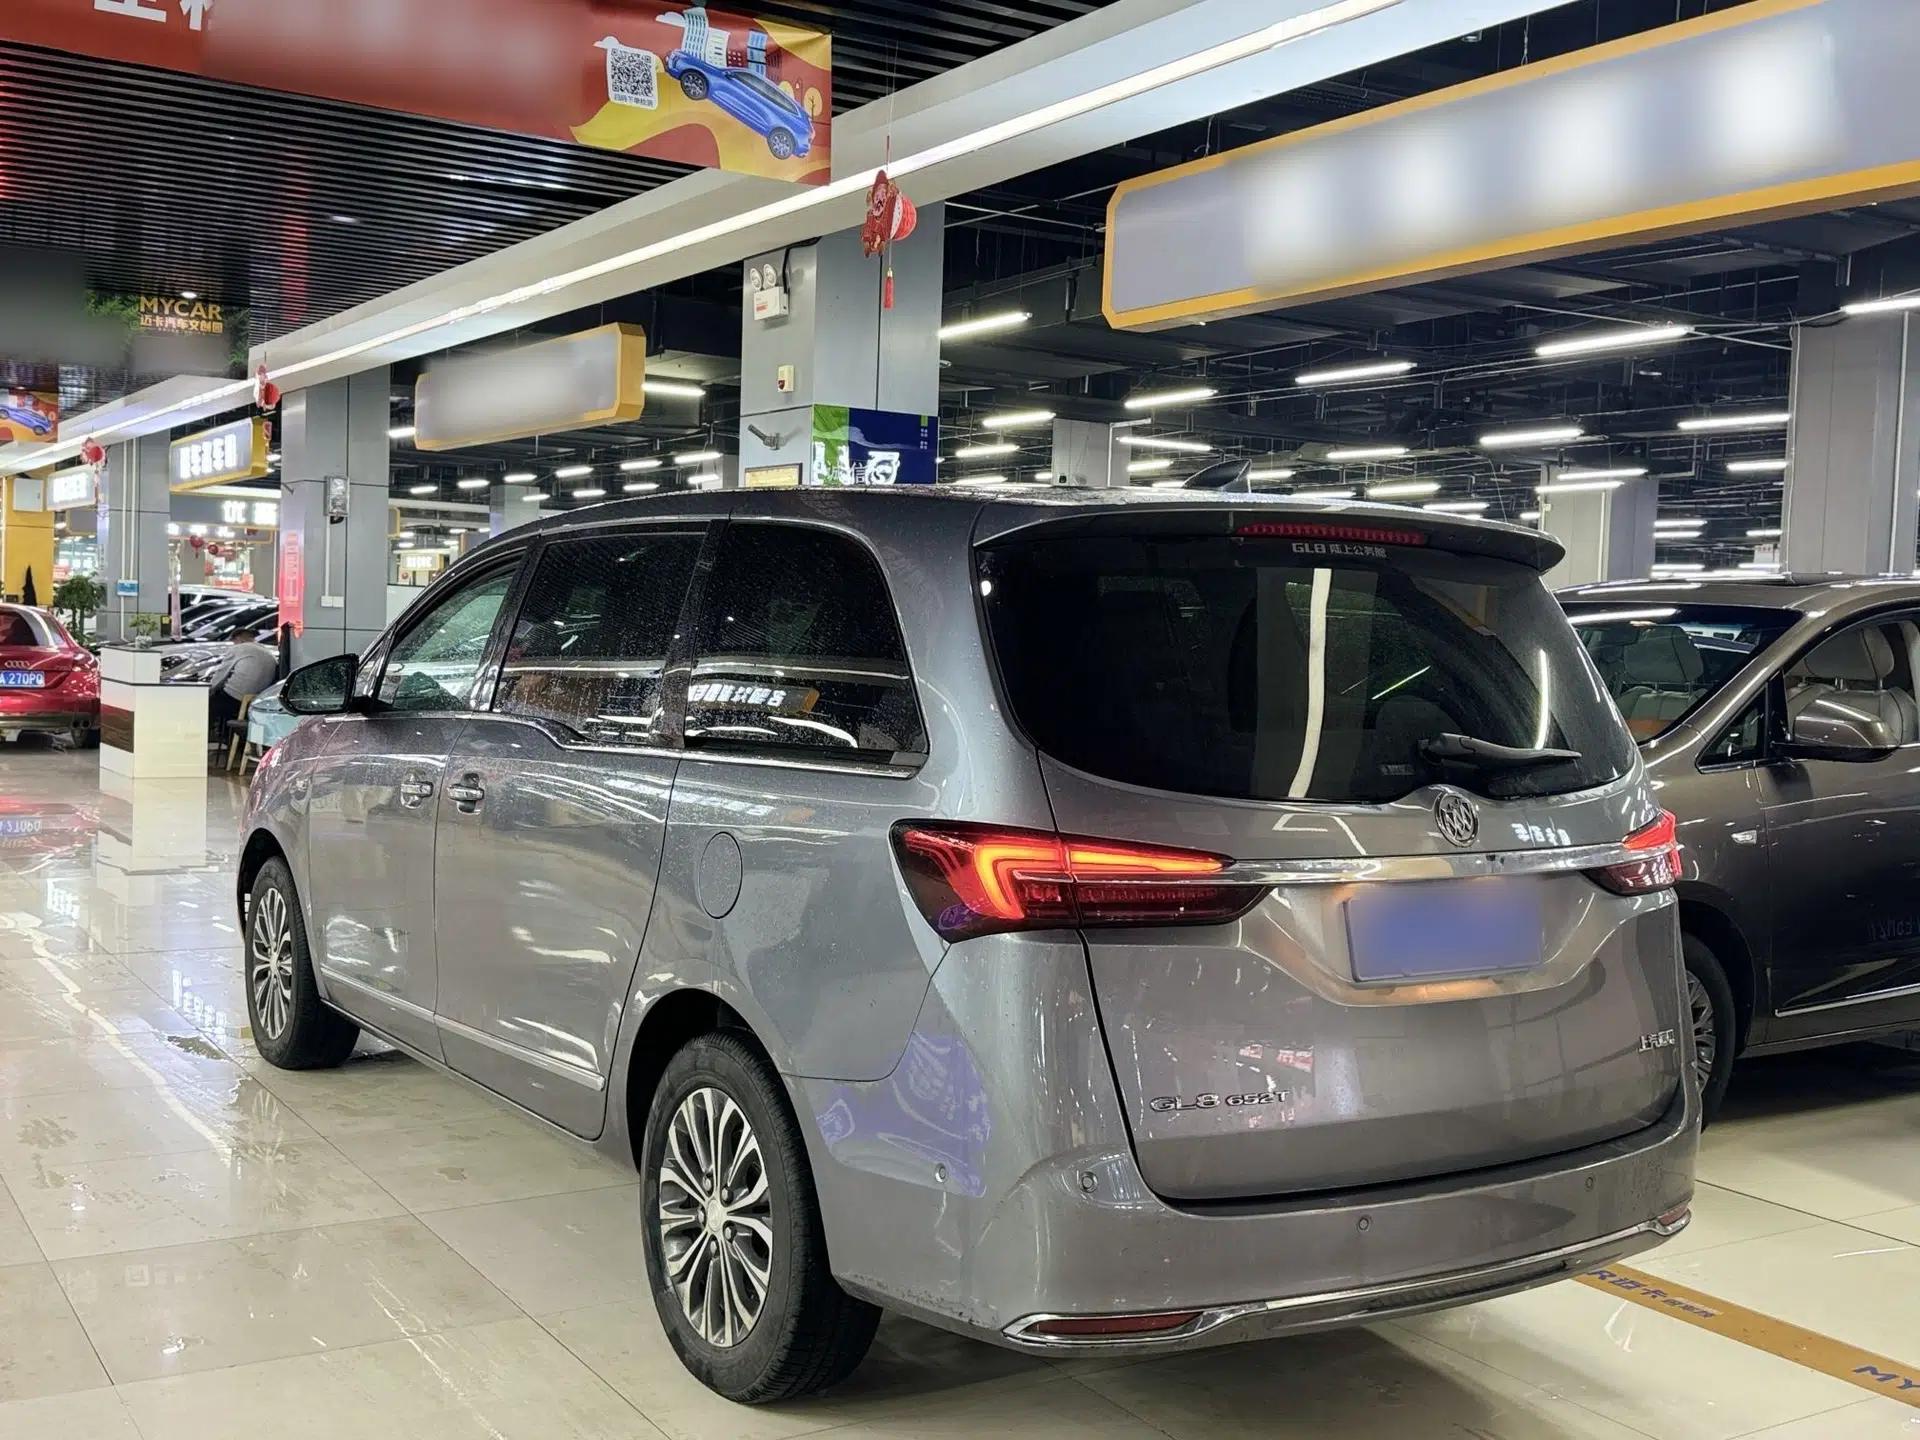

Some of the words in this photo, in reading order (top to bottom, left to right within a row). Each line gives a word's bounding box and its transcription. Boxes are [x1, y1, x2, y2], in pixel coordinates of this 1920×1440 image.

[139, 295, 223, 321] MYCAR
[1291, 542, 1327, 554] GL8
[1150, 1092, 1221, 1113] GL8
[1225, 1090, 1290, 1107] 652T
